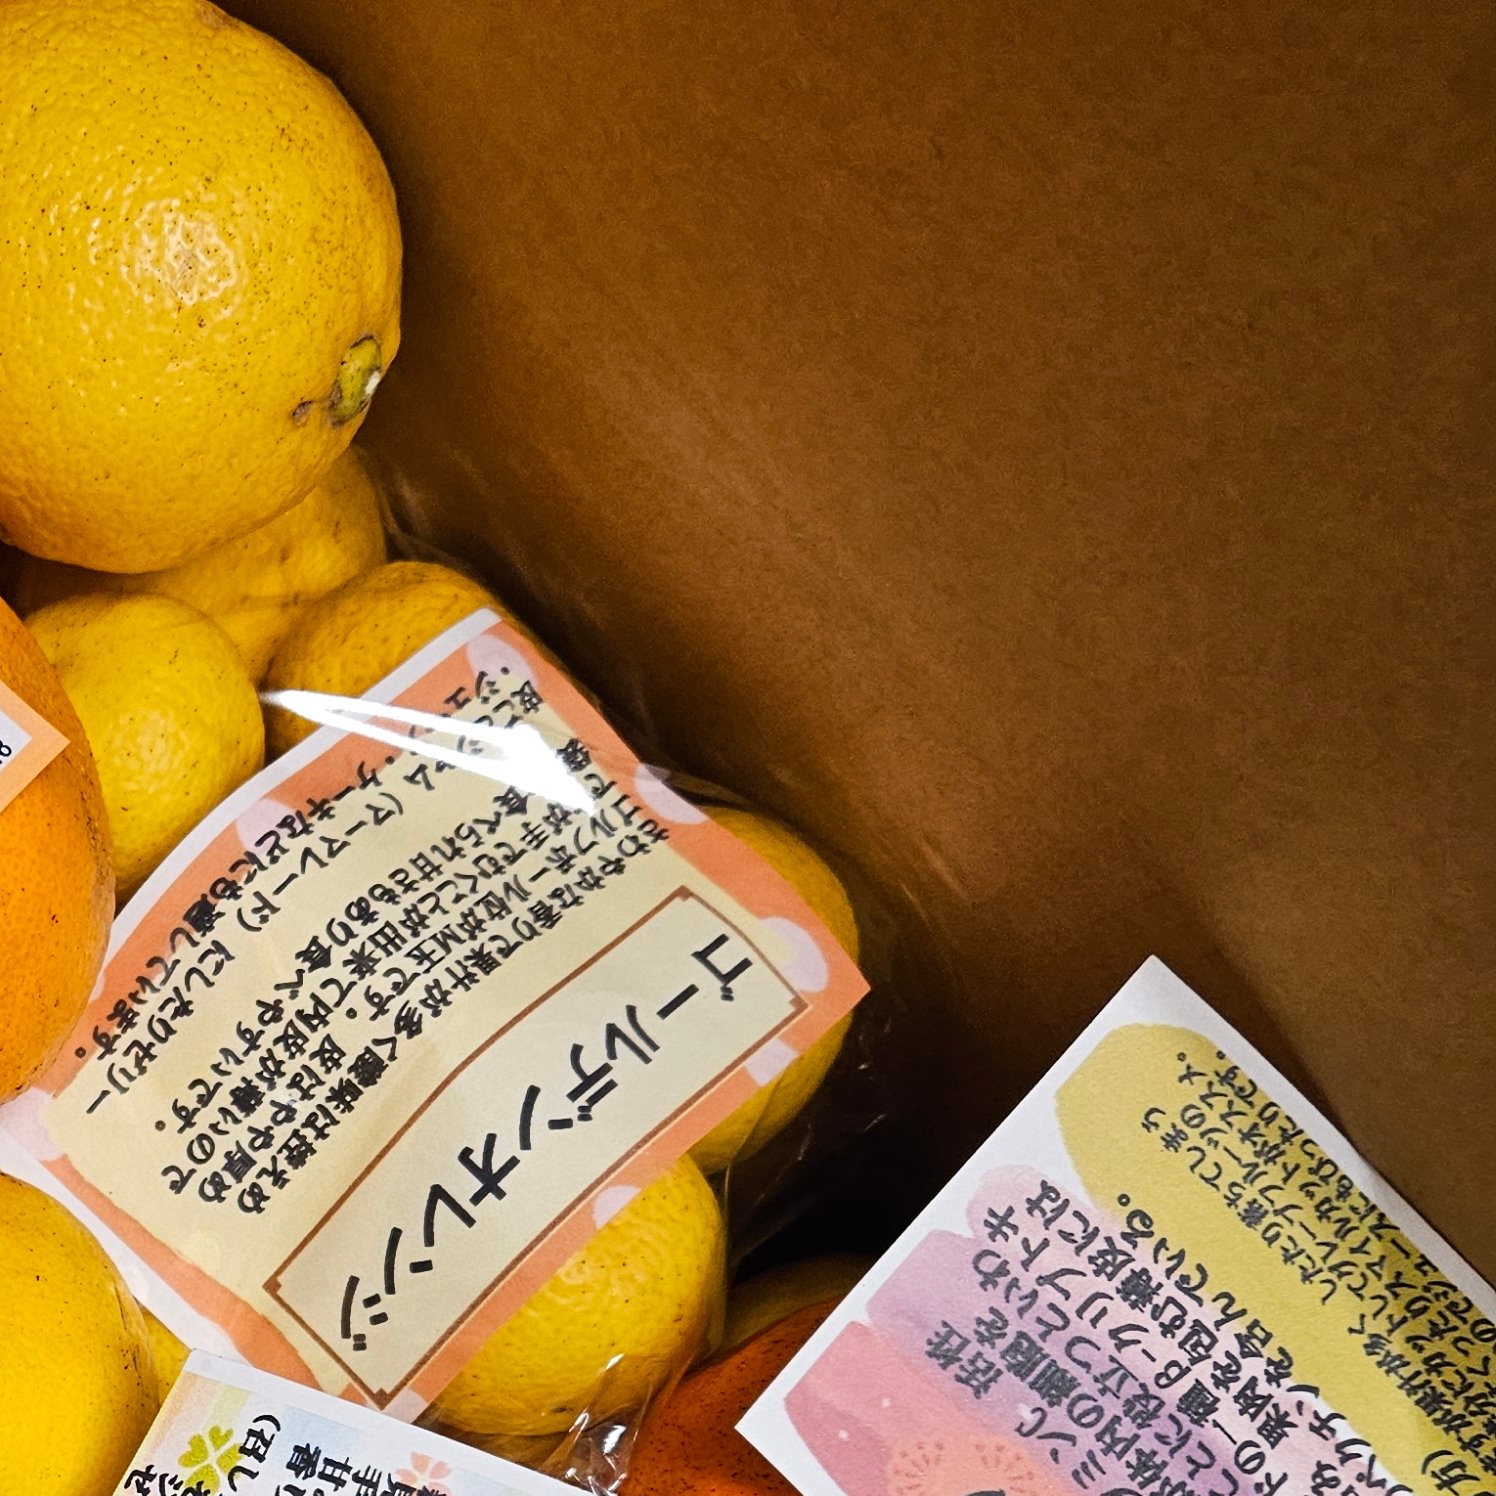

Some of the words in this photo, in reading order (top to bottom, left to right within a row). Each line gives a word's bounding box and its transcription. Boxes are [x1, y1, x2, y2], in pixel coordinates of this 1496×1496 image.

[156, 739, 591, 1133] 袋食べられ甘さもあり食べやすいです。
[162, 774, 616, 1192] でが手でむくことが出来て内皮が薄いので
[238, 820, 668, 1213] さわやかな香りで果汁が多く酸味は控えめ
[341, 934, 752, 1351] ゴールデンオレンジ
[1026, 1180, 1298, 1449] 果肉を包む薄皮には
[1142, 1108, 1336, 1305] したたり落ちてしまう
[1215, 1051, 1496, 1353] のでジュースにもぴったりです。
[926, 1321, 1003, 1399] 活性
